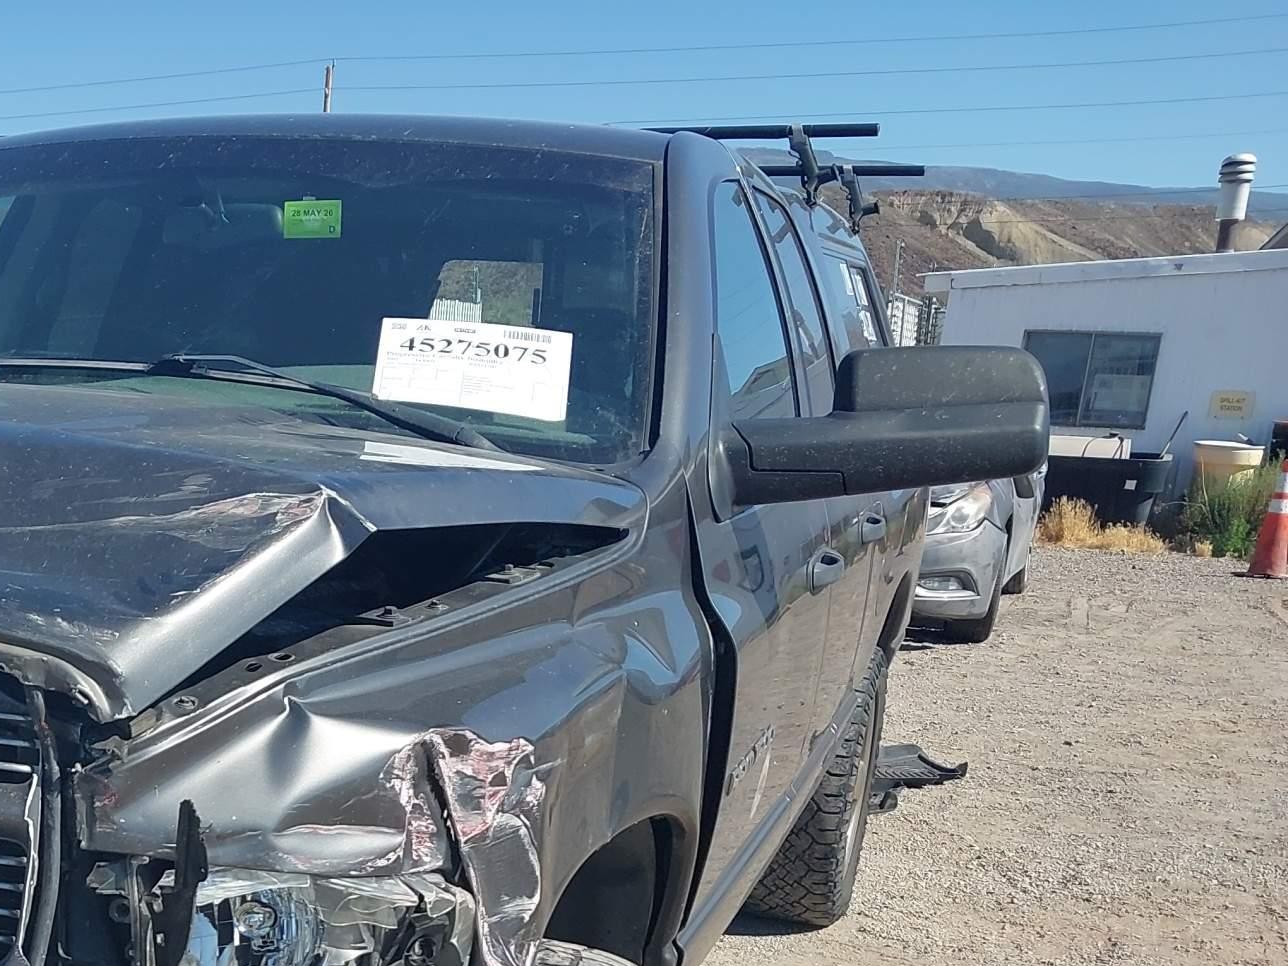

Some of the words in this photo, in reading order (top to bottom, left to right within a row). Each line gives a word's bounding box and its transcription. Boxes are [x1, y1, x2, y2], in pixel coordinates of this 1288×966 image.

[303, 209, 322, 217] MAY
[329, 225, 336, 233] D
[399, 336, 548, 366] 45275075
